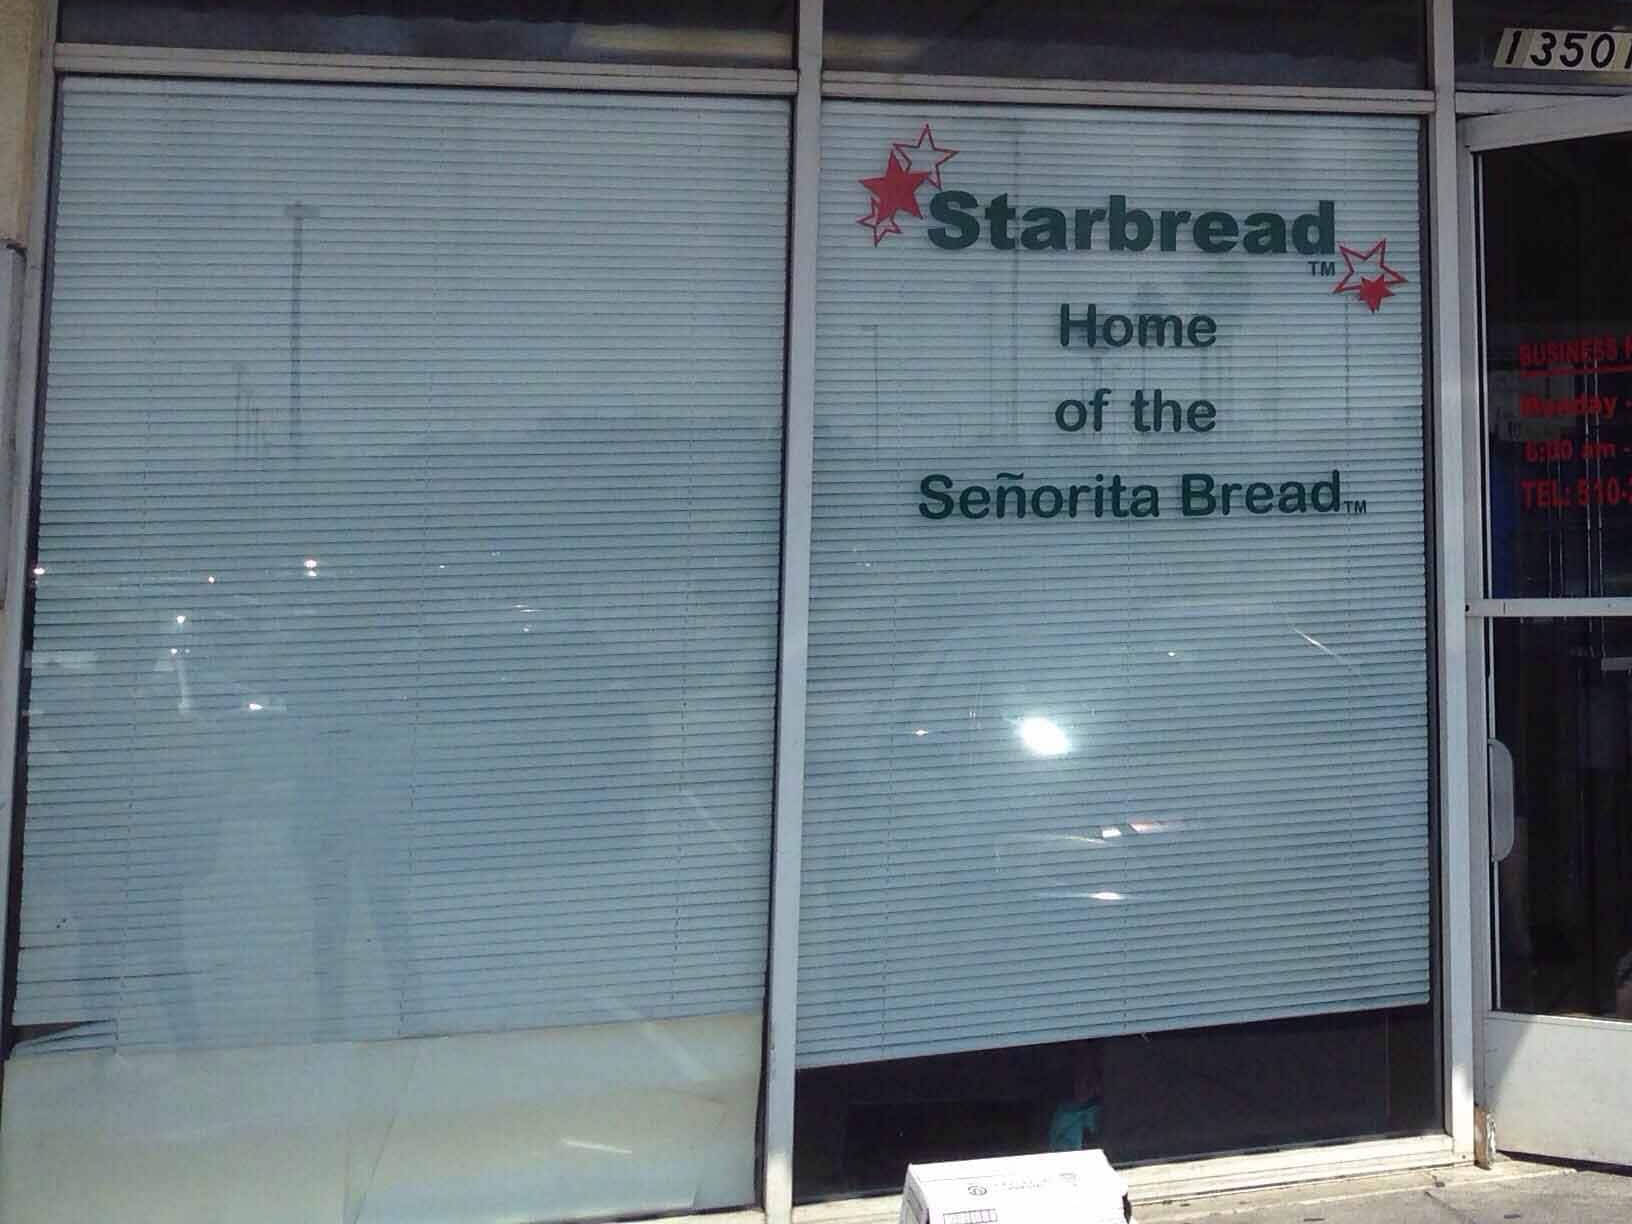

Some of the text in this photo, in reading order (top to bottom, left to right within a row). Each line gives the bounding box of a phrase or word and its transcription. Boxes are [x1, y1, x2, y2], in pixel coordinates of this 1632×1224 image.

[927, 190, 1336, 256] Starbread
[1059, 303, 1217, 348] Home
[1520, 336, 1617, 365] BUSINESS
[1055, 389, 1217, 432] of the
[918, 471, 1161, 520] Señorita
[1181, 470, 1340, 516] Bread
[1520, 476, 1571, 510] TEL:
